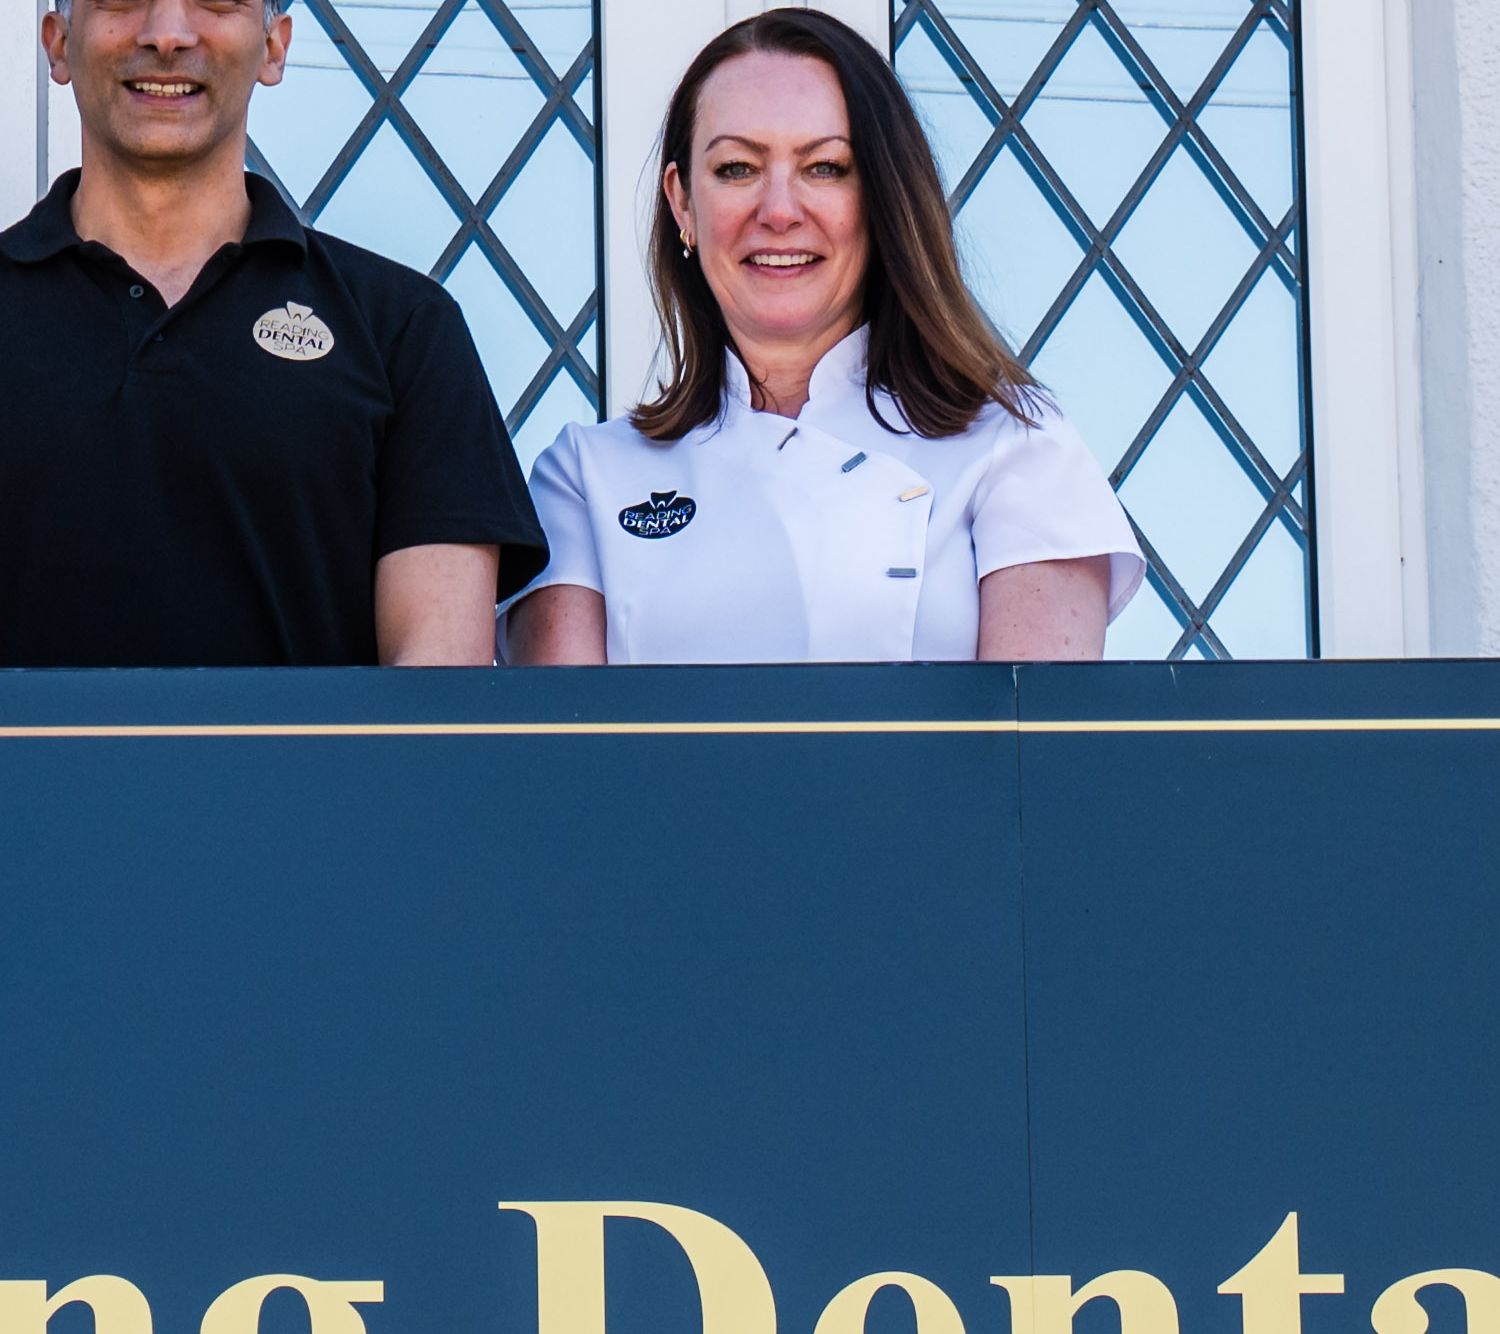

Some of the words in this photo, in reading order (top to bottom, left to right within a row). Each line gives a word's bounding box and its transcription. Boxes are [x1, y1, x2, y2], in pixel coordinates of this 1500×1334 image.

[260, 319, 330, 340] READING
[258, 329, 326, 351] DENTAL
[273, 341, 306, 356] SPA
[624, 504, 692, 520] READING
[623, 514, 689, 529] DENTAL
[638, 527, 672, 536] SPA
